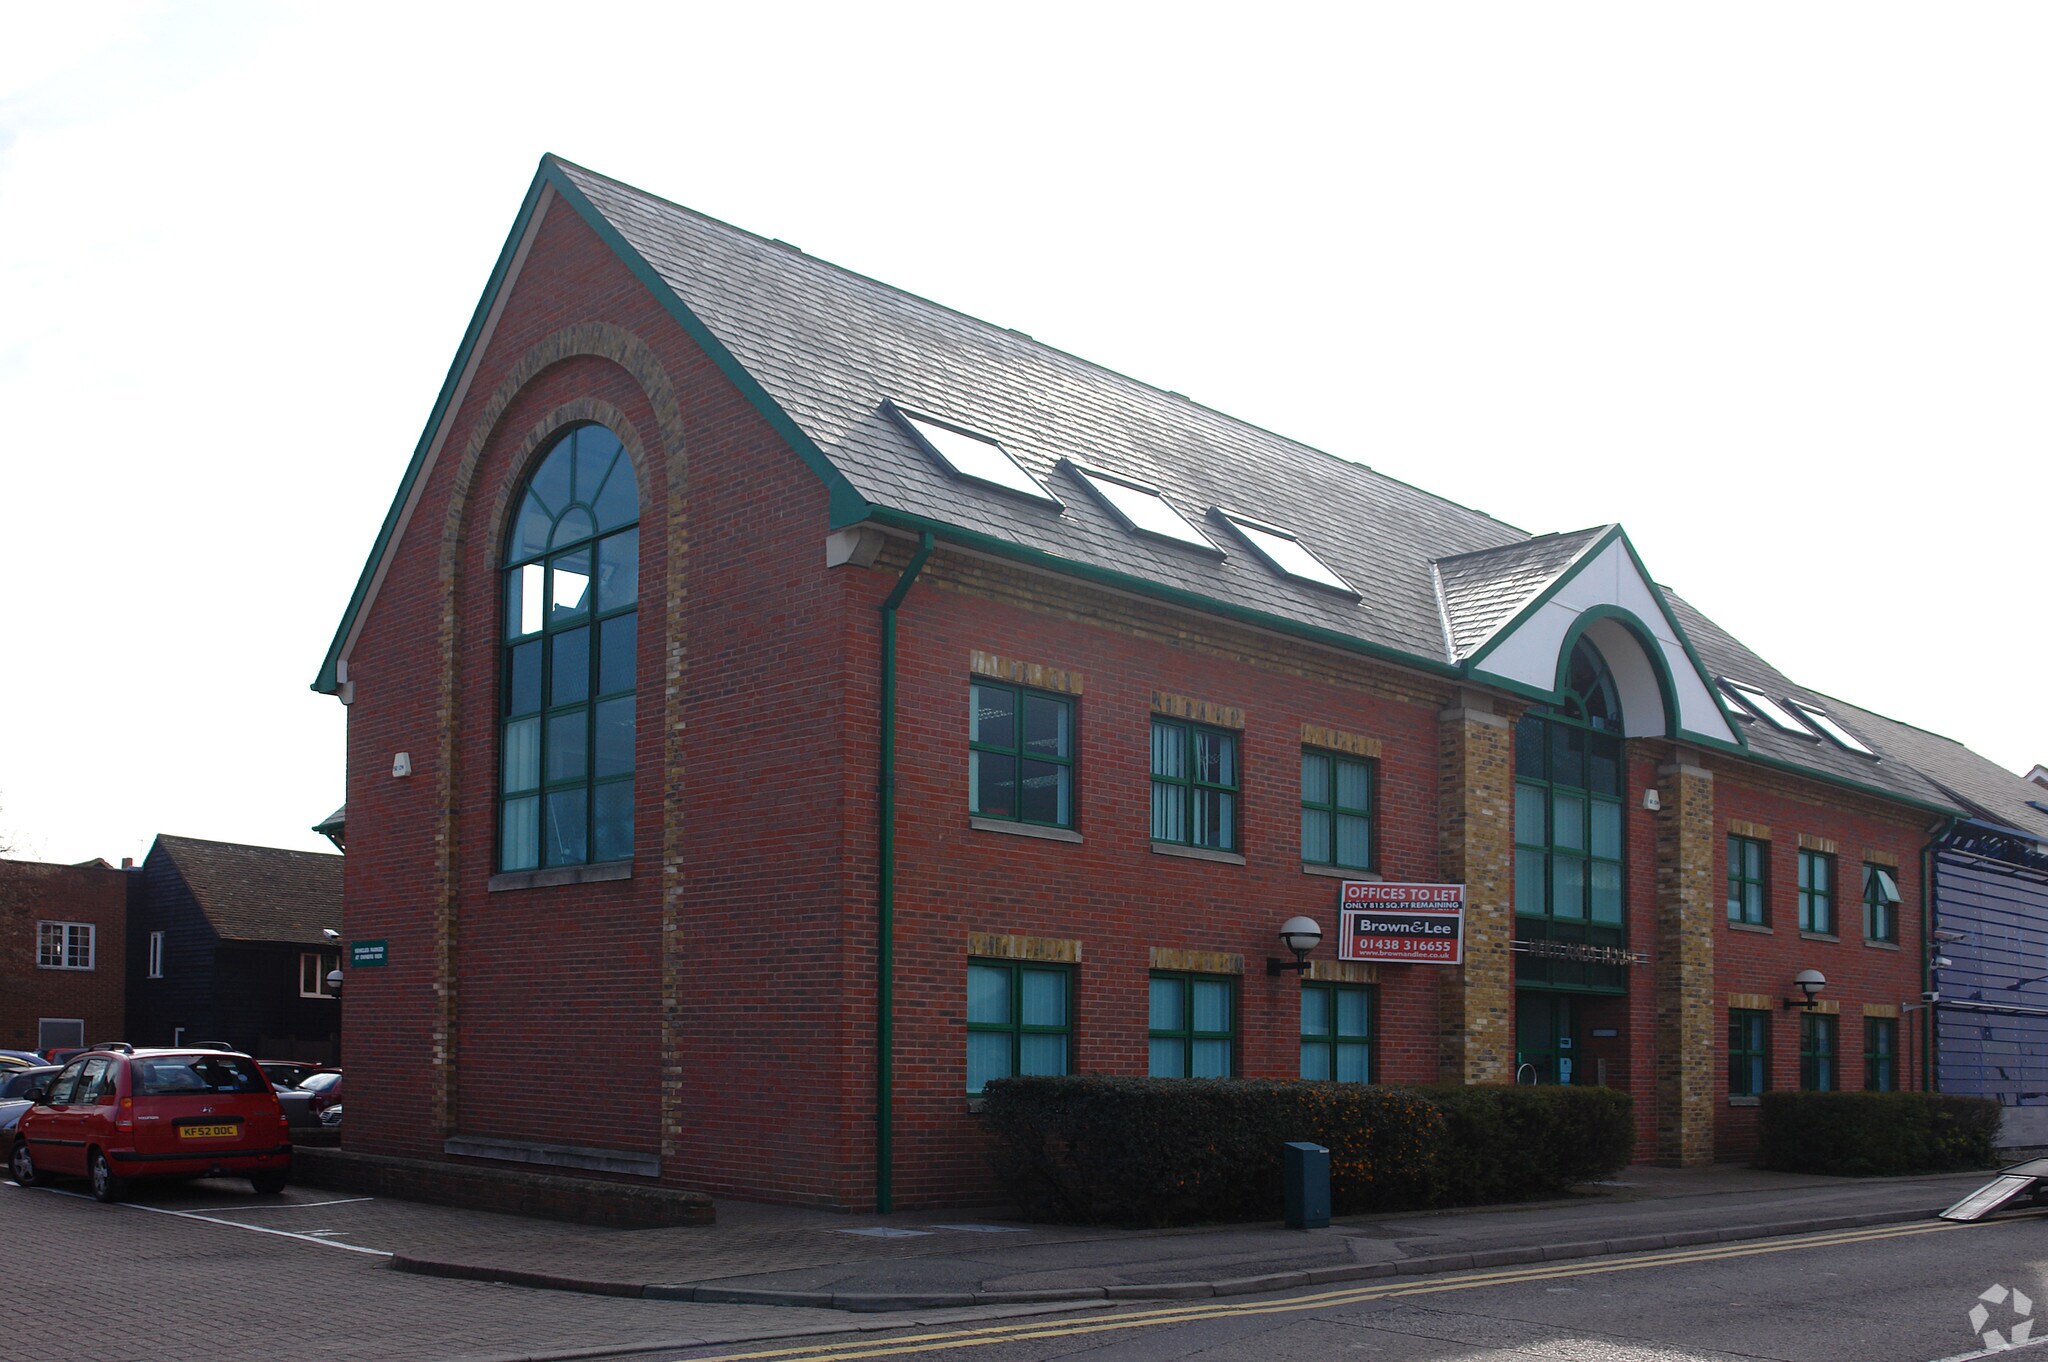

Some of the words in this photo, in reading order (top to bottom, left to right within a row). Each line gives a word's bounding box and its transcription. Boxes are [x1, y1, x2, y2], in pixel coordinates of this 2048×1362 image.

[1348, 887, 1406, 900] OFFICES
[1410, 888, 1430, 900] TO
[1434, 889, 1457, 901] LET
[1345, 901, 1368, 909] ONLY
[1410, 901, 1459, 909] REMAINING
[1360, 919, 1452, 934] Brown&Lee
[1359, 939, 1399, 950] 01438
[1403, 940, 1451, 952] 316655
[1359, 950, 1450, 959] www.brownandlee.co.uk
[184, 1127, 212, 1136] KF52
